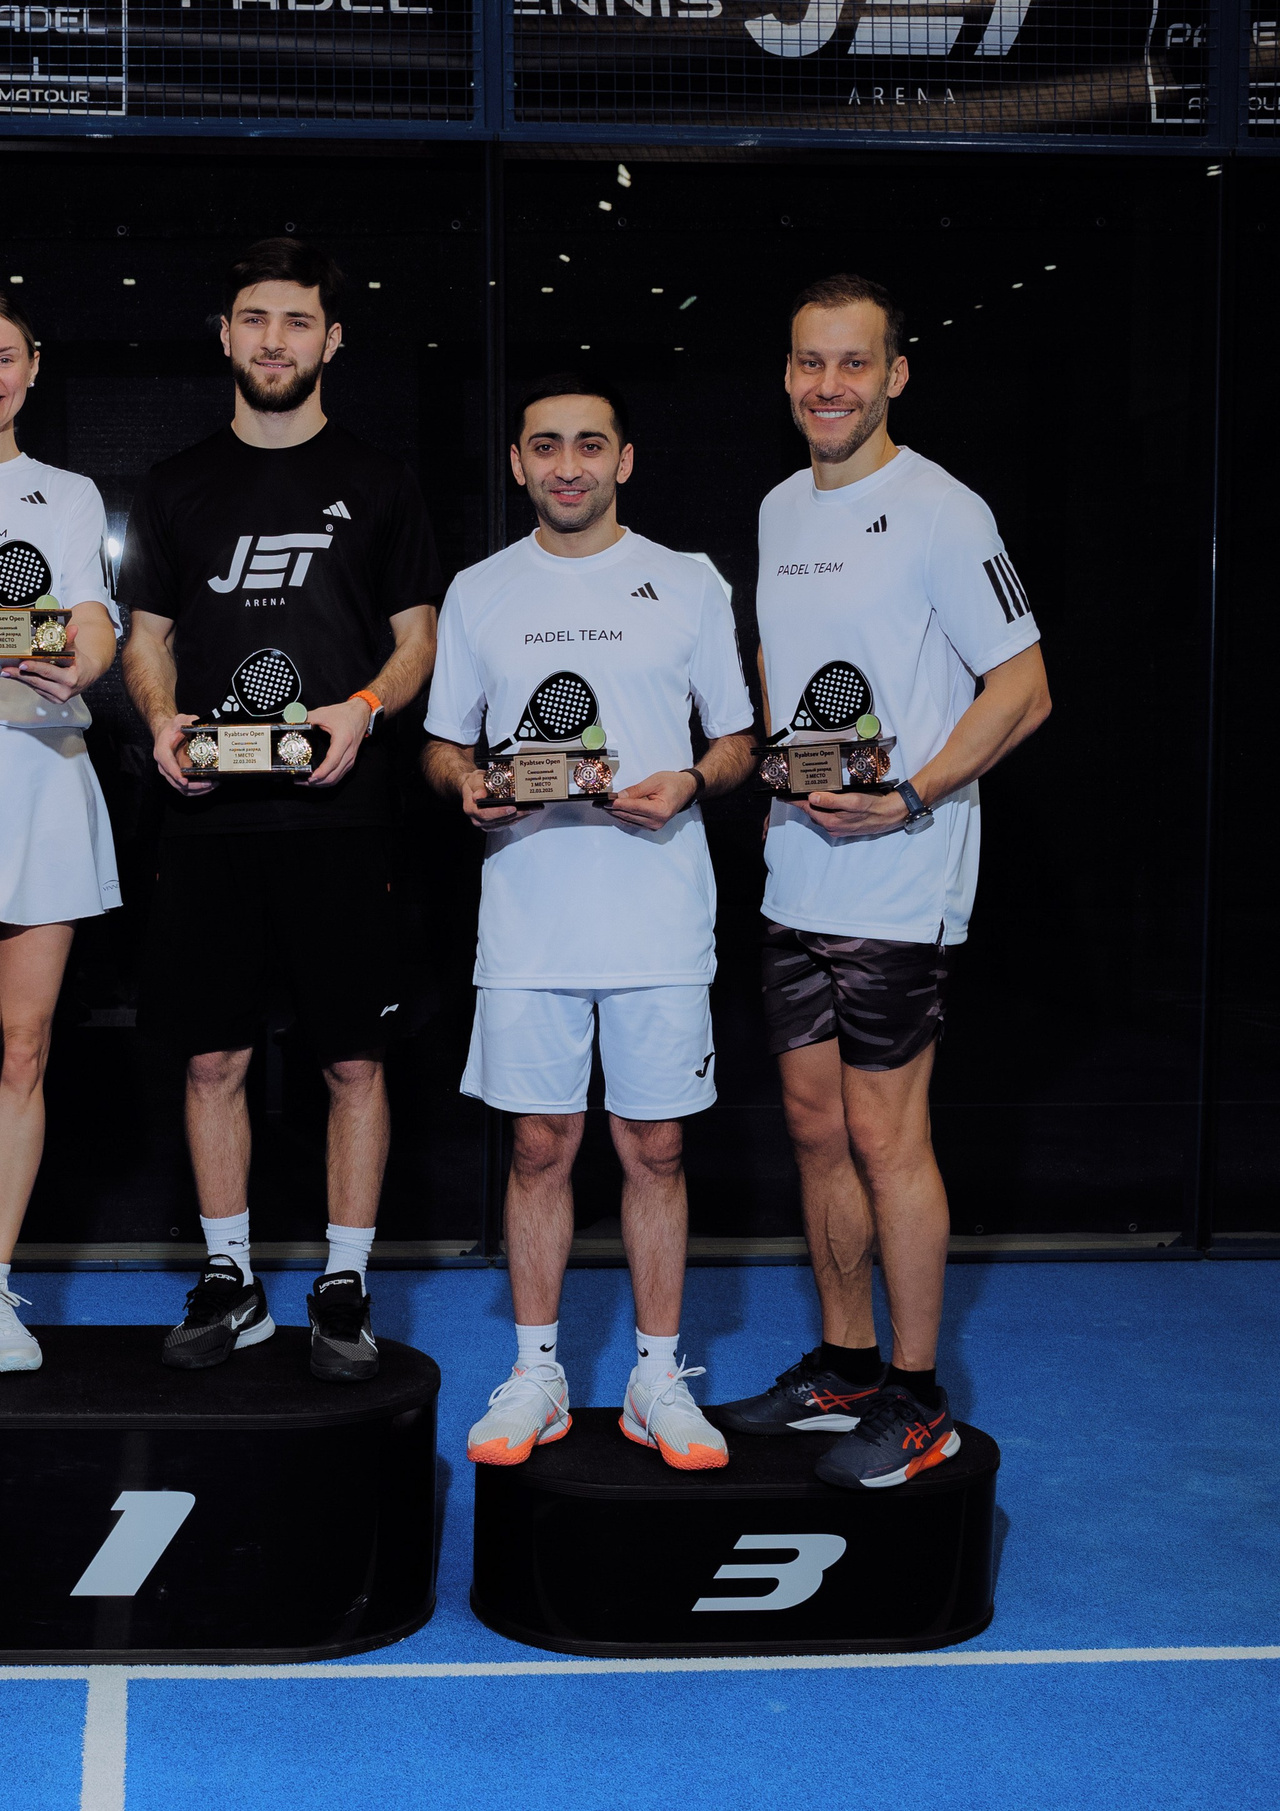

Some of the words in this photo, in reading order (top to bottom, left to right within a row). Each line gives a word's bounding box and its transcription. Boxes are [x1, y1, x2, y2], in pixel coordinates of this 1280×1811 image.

[848, 87, 957, 105] ARENA
[207, 533, 334, 593] JET
[777, 563, 810, 577] PADEL
[813, 562, 844, 575] TEAM
[245, 597, 286, 607] ARENA
[524, 631, 575, 645] PADEL
[578, 629, 623, 642] TEAM
[794, 751, 819, 759] Ryabtsev
[70, 1490, 196, 1597] 1
[692, 1533, 847, 1612] 3
